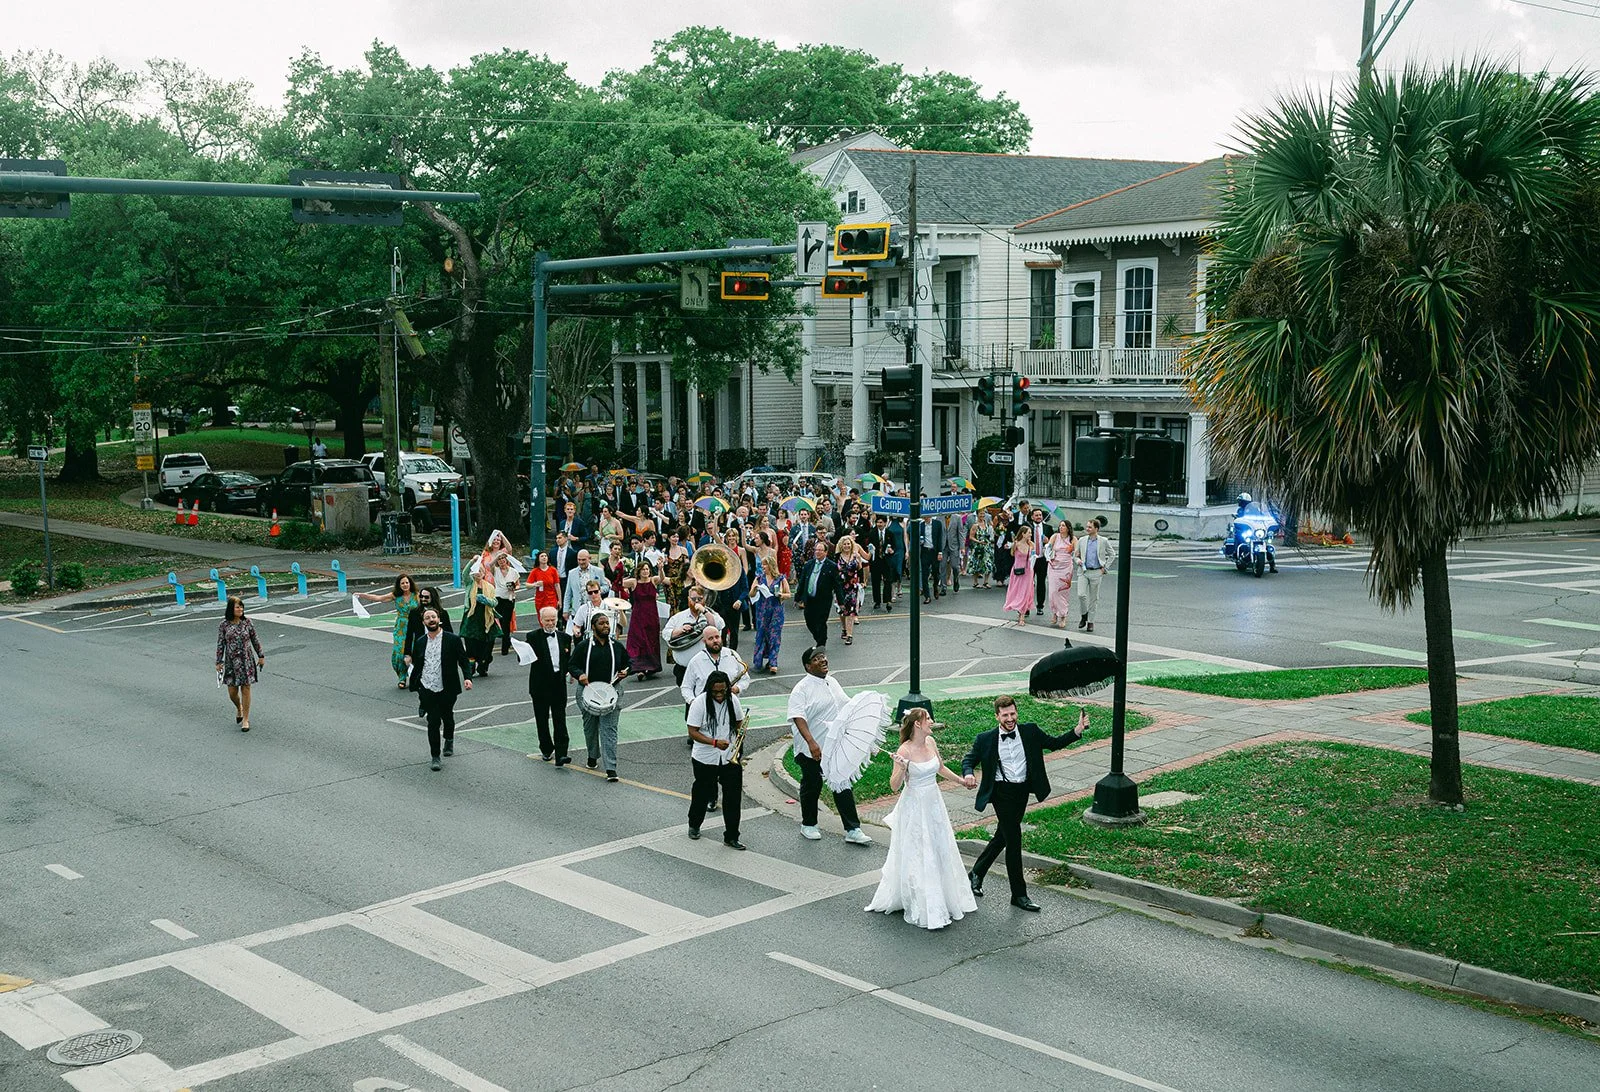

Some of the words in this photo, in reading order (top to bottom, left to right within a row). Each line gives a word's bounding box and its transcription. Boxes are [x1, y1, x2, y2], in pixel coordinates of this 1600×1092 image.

[685, 297, 704, 306] ONLY
[135, 421, 151, 431] 20
[880, 497, 902, 511] Camp
[922, 497, 969, 511] Melpomene
